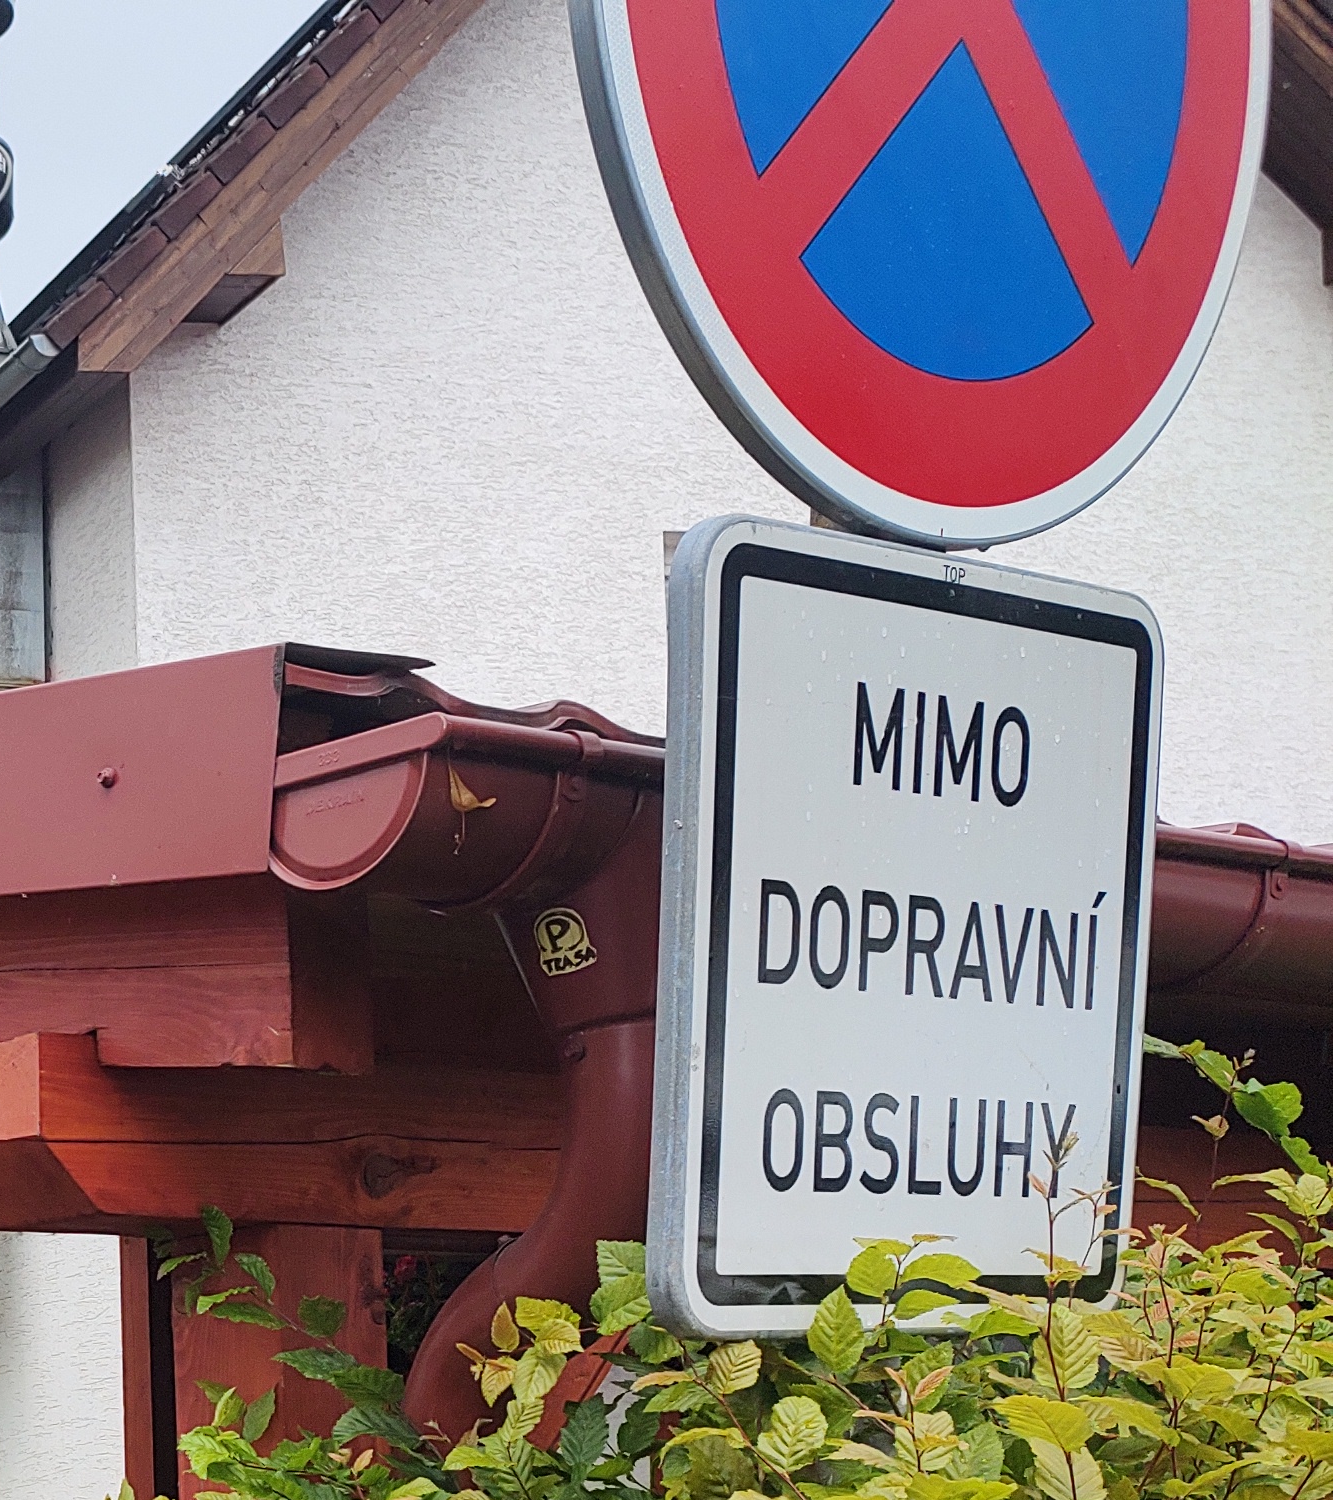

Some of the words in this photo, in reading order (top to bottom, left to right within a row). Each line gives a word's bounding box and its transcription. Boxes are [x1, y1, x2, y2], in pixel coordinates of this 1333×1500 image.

[944, 565, 966, 584] TOP
[852, 681, 1031, 806] MIMO
[757, 878, 1107, 1011] DOPRAVNÍ
[762, 1087, 1077, 1200] OBSLUHY
